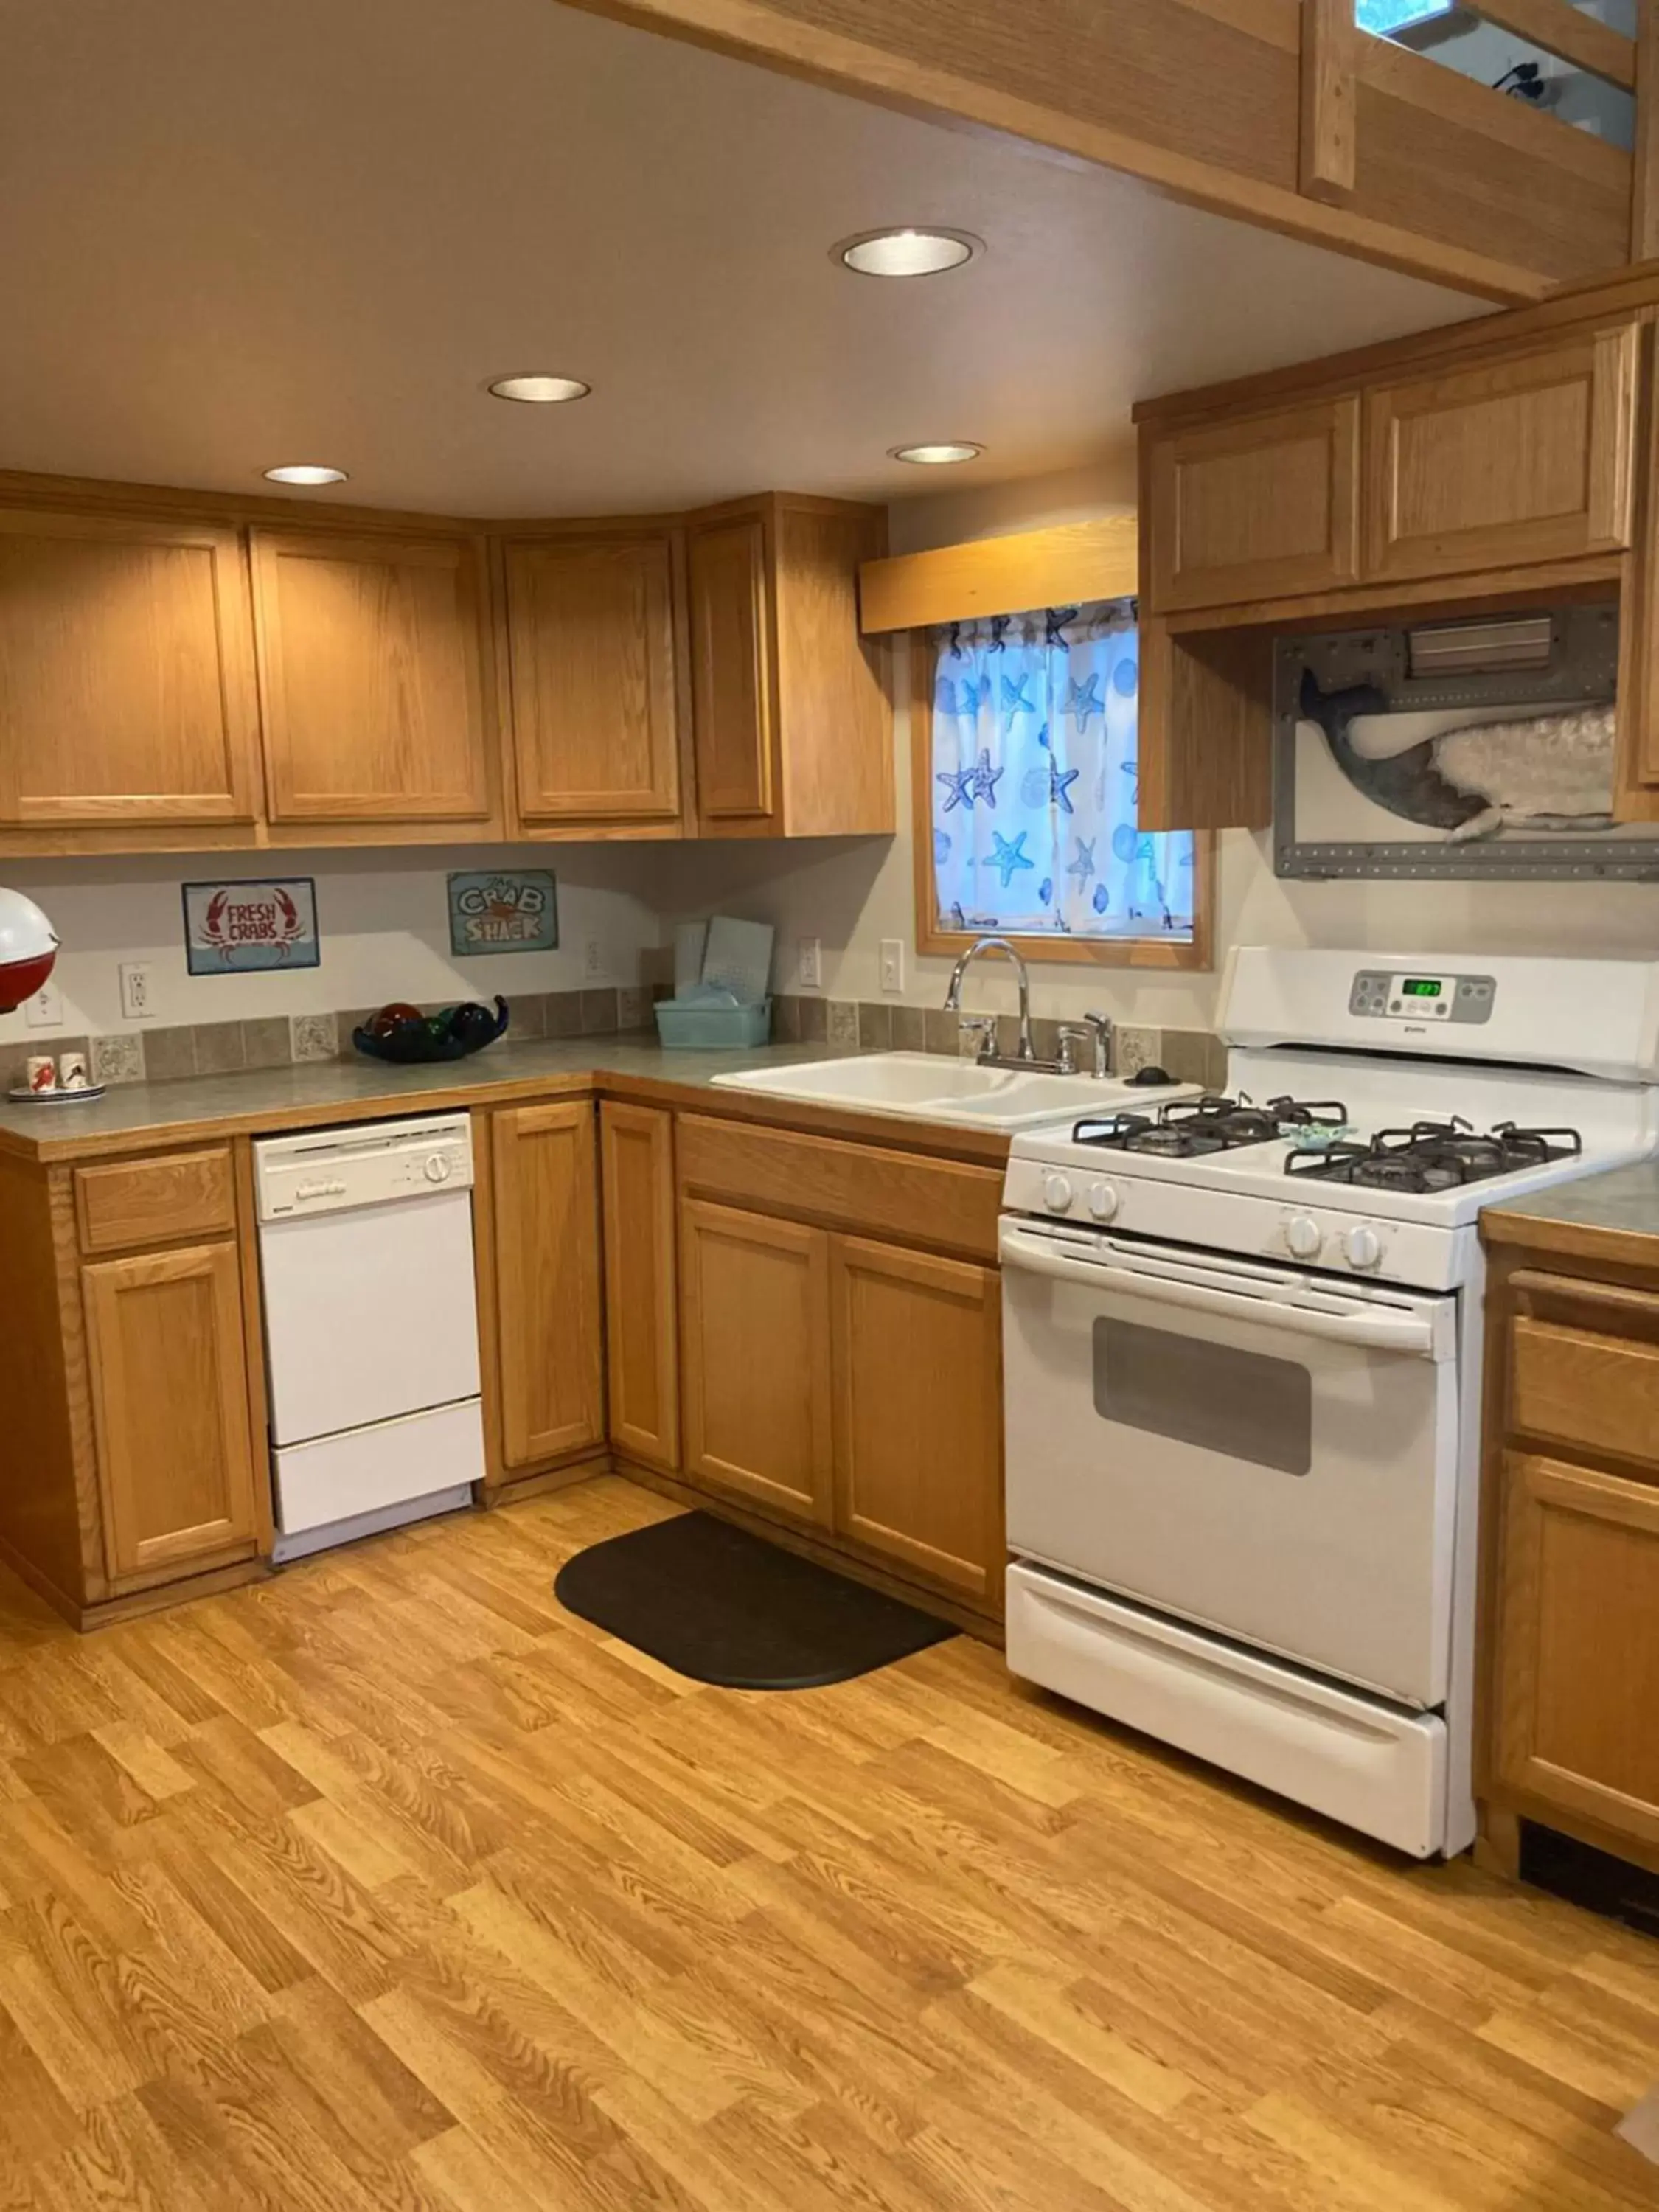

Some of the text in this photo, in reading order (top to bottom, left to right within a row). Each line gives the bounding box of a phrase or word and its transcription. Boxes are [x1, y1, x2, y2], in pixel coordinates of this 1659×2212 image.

[457, 885, 546, 915] CRAB
[227, 903, 276, 924] FRESH
[229, 922, 278, 940] CRABS
[465, 917, 543, 942] SHACK
